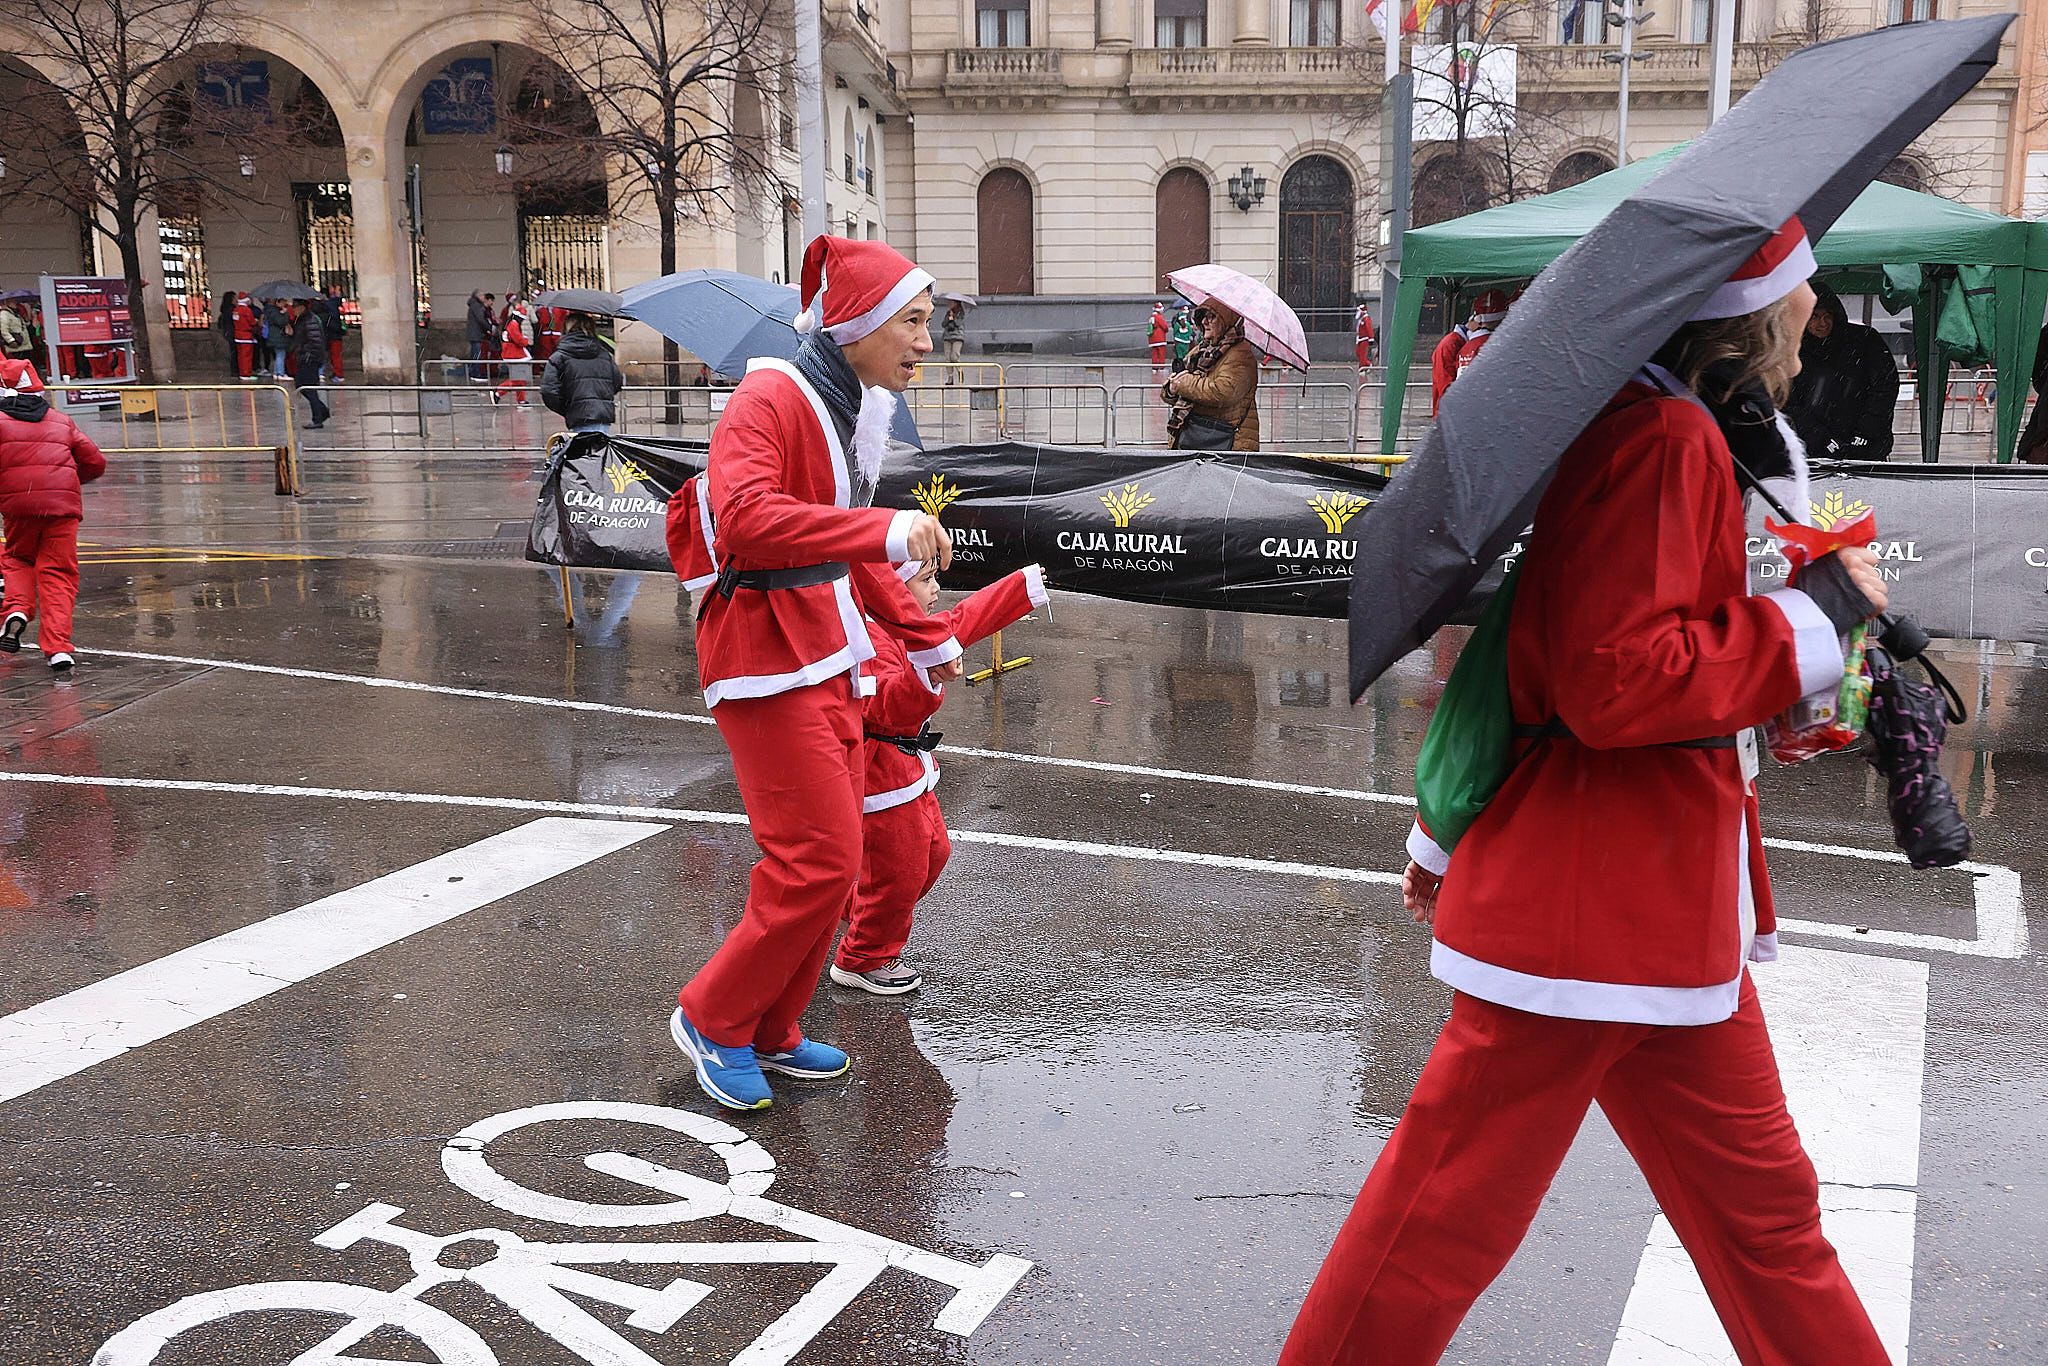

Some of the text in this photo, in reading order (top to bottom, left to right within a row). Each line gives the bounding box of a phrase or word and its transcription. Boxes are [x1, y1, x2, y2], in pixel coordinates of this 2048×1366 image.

[58, 294, 109, 307] ADOPTA
[564, 490, 667, 515] CAJA RURAL
[570, 512, 649, 529] DE ARAGÓN
[948, 527, 993, 547] RAL
[1056, 531, 1187, 554] CAJA RURAL
[951, 548, 985, 562] GÓN
[1260, 537, 1320, 559] CAJA
[1745, 538, 1923, 562] CA RAL
[1074, 556, 1174, 572] DE ARAGÓN
[1276, 564, 1302, 575] DE
[1760, 563, 1789, 578] DE
